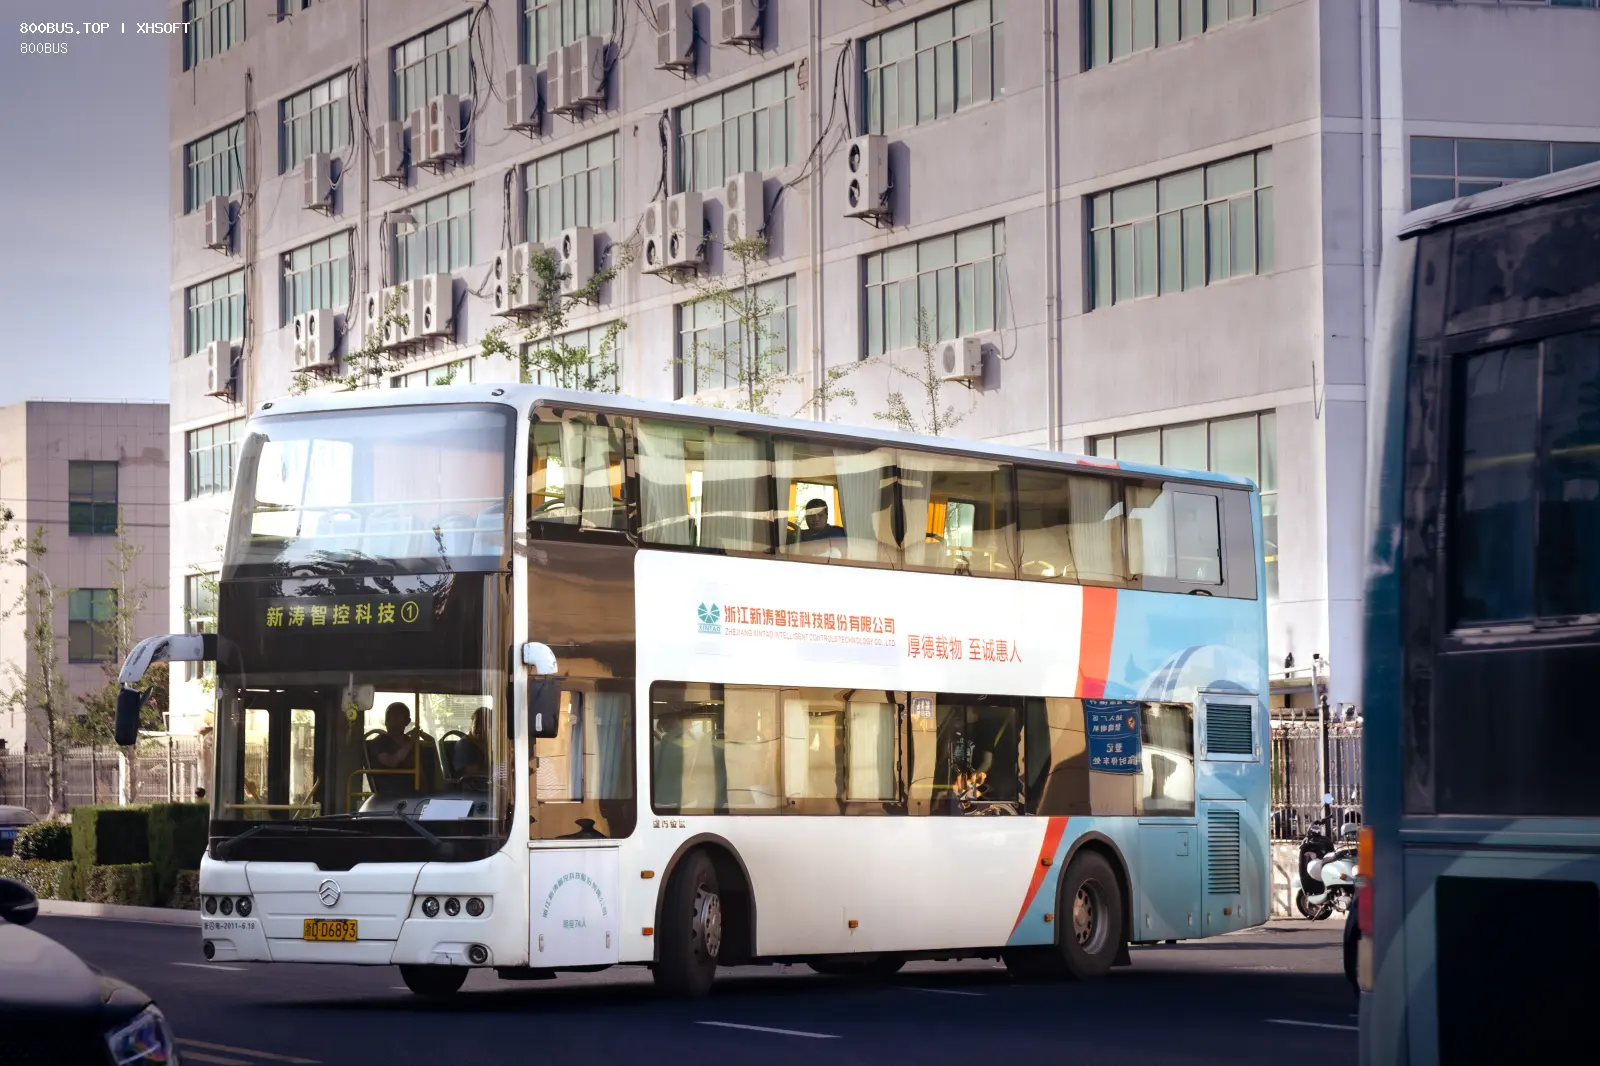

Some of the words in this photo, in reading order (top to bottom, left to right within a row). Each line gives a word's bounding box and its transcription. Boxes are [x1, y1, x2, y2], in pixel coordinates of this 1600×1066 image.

[698, 625, 721, 633] XINTAO
[723, 604, 896, 635] 浙江新涛智控科技股份有限公司
[725, 628, 752, 637] ZHEJIANG
[906, 634, 963, 661] 厚德载物
[968, 637, 1022, 664] 至诚惠人
